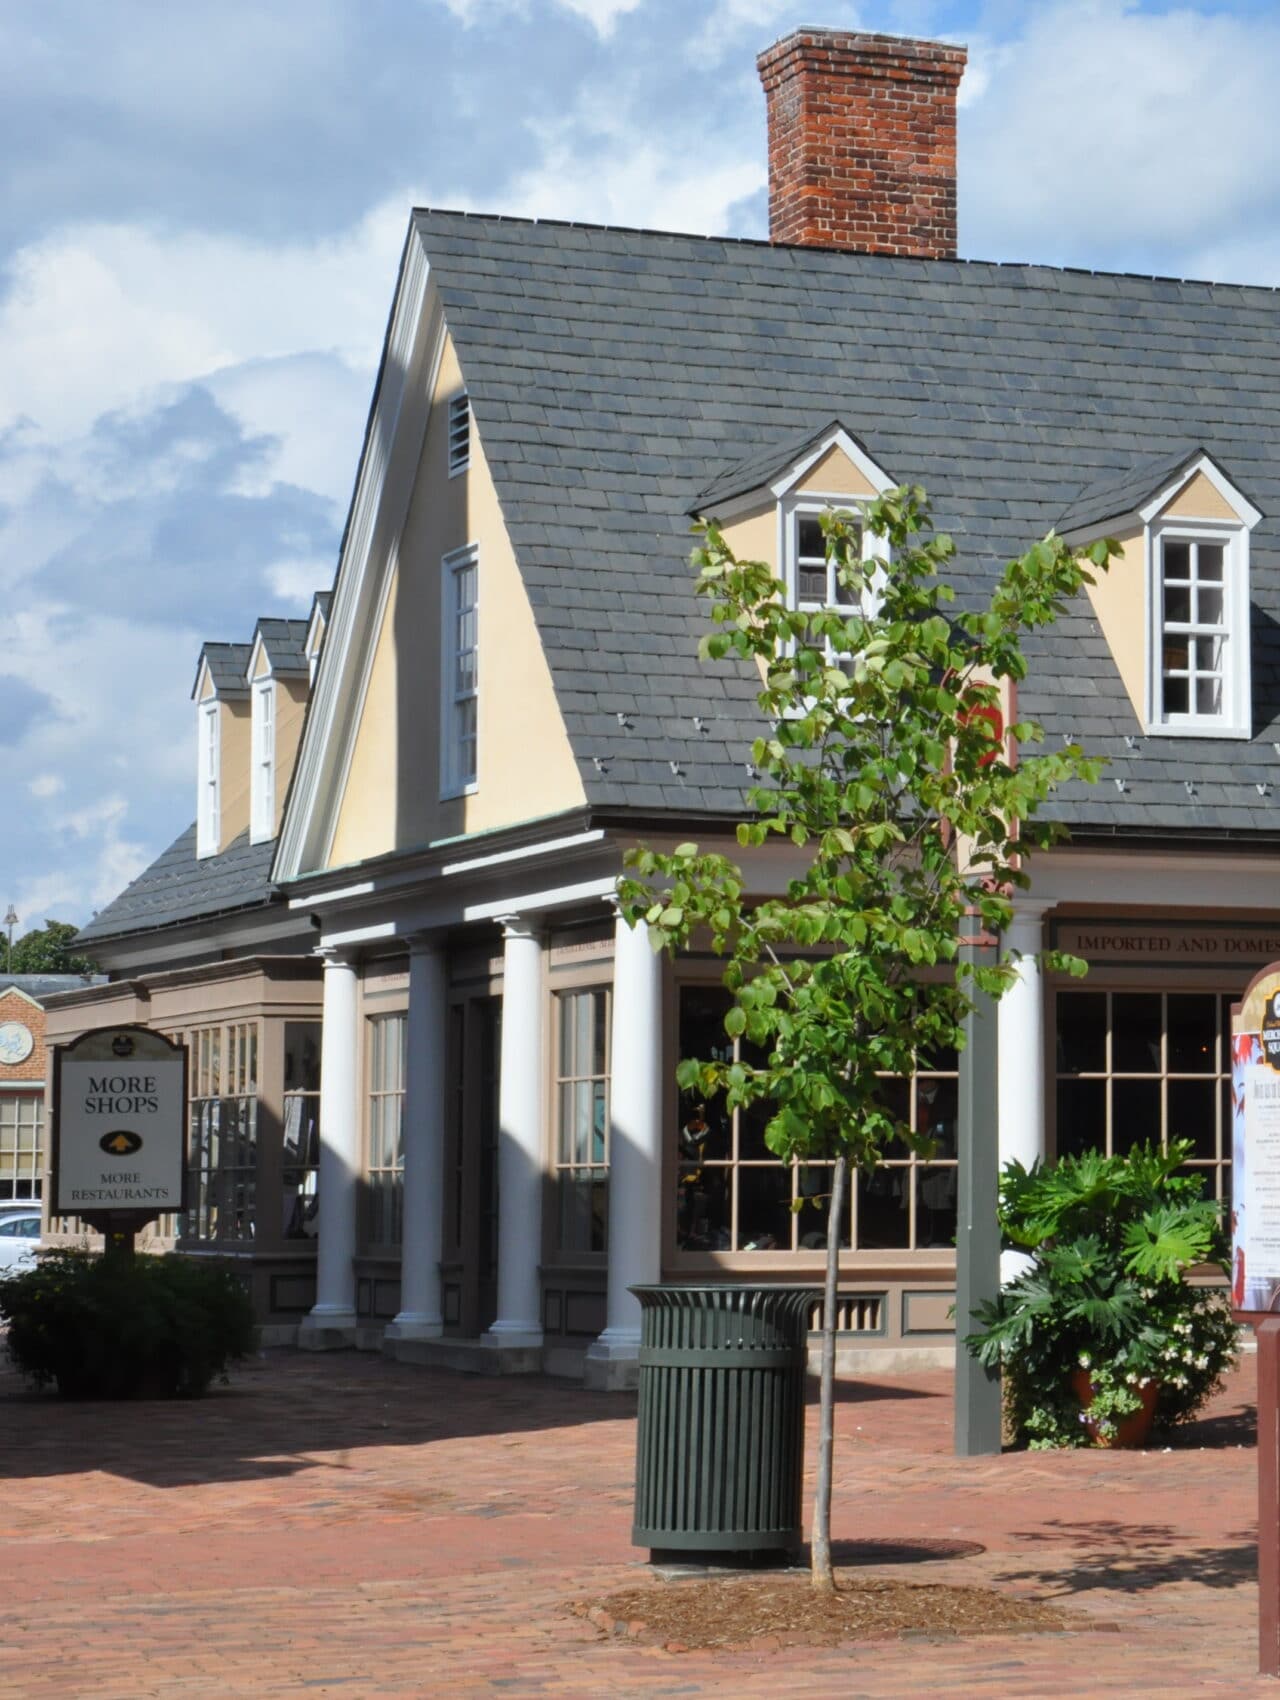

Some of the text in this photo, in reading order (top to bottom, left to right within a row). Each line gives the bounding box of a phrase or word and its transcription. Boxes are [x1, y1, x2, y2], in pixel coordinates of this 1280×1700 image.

[1077, 935, 1171, 950] IMPORTED
[1178, 937, 1218, 952] AND
[88, 1076, 157, 1094] MORE
[84, 1096, 159, 1114] SHOPS
[100, 1173, 141, 1185] MORE
[71, 1188, 169, 1201] RESTAURANTS
